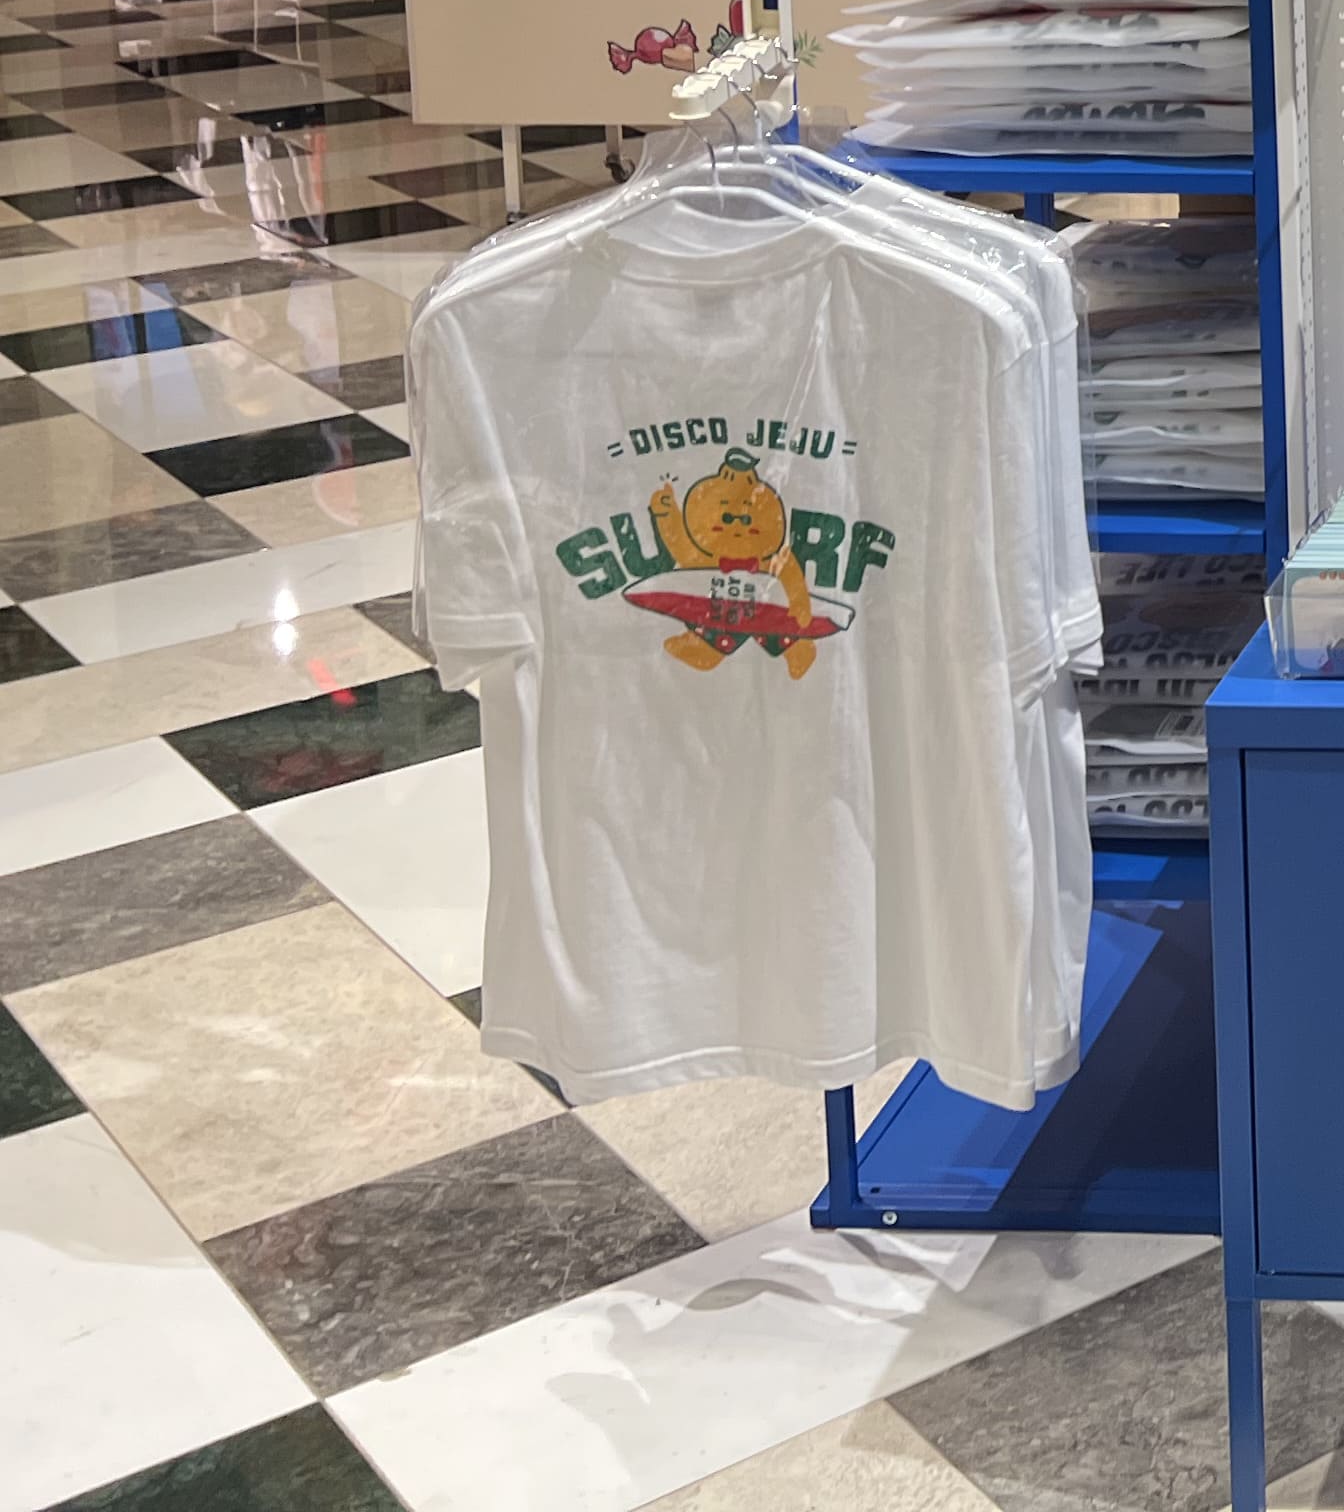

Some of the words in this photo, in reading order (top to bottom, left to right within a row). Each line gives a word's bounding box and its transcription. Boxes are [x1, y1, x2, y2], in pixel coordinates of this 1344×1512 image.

[628, 417, 729, 456] DISCO
[746, 418, 836, 459] JEJU
[556, 508, 896, 600] SURF
